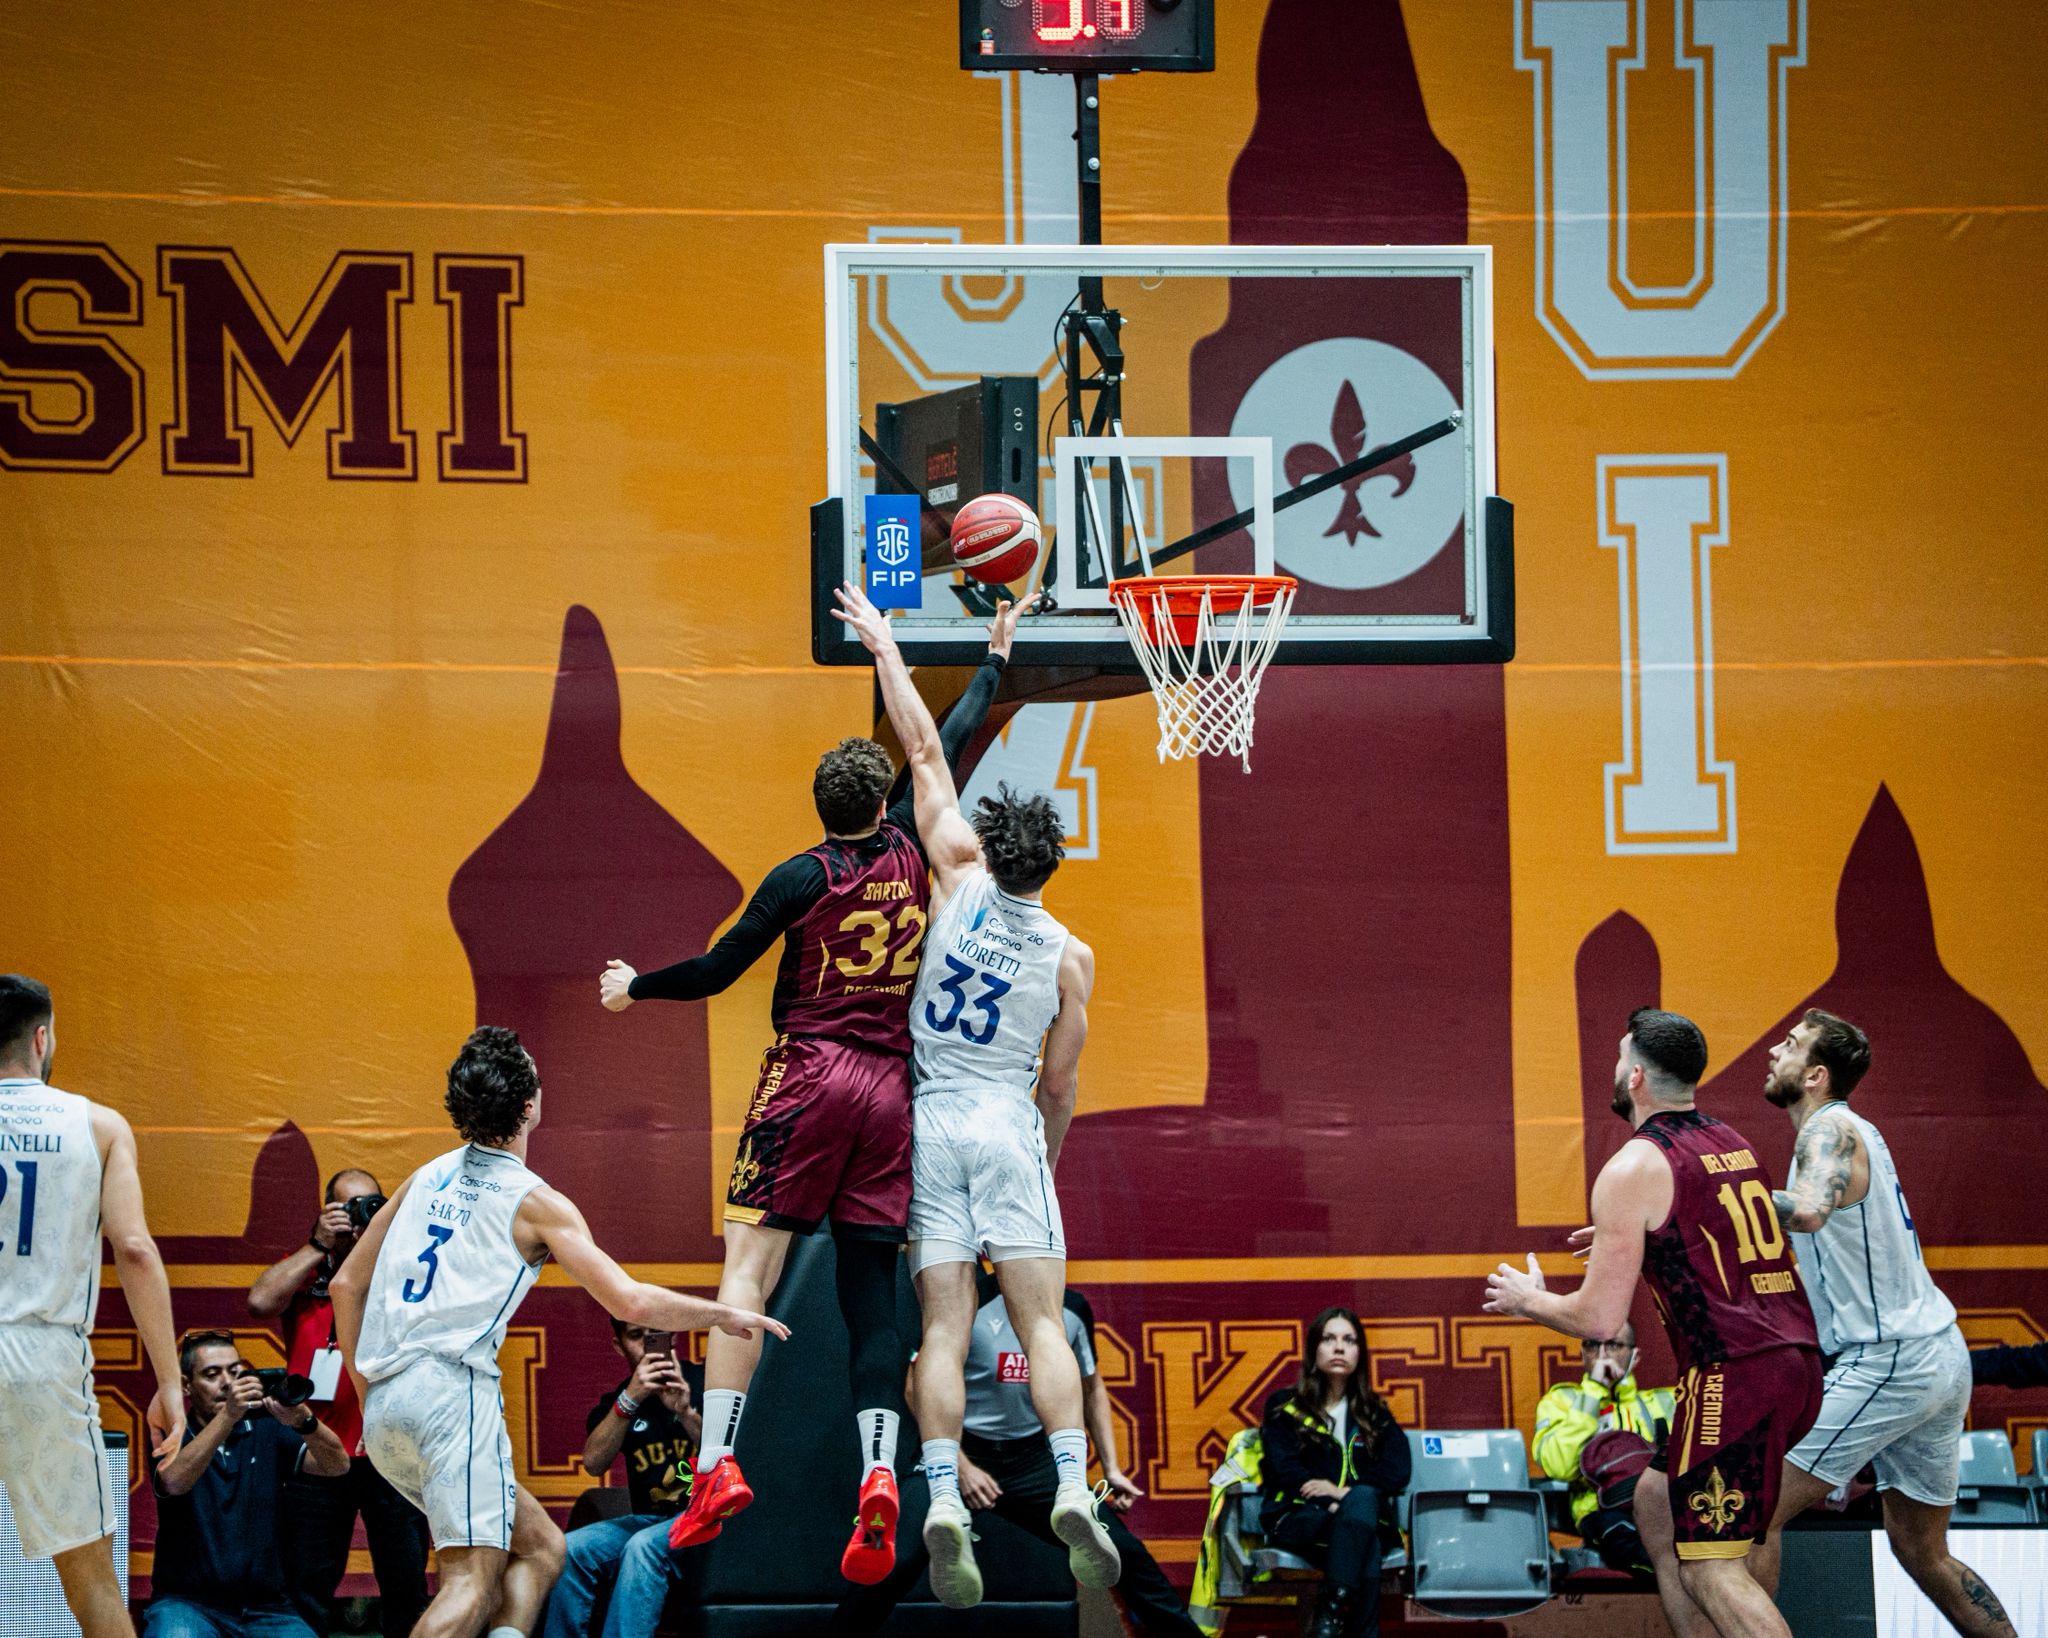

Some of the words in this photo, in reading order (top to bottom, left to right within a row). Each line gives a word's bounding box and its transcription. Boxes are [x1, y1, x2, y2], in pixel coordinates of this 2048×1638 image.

[0, 238, 528, 484] SMI
[872, 570, 916, 587] FIP
[835, 905, 927, 977] 32
[953, 934, 1021, 977] MORETTI
[983, 929, 1022, 951] Innova
[989, 917, 1044, 946] Consorzio
[925, 953, 1012, 1045] 33
[1700, 1153, 1727, 1175] DEL
[1716, 1179, 1785, 1264] 10
[402, 1224, 454, 1303] 3
[1700, 1373, 1725, 1446] CREMONA
